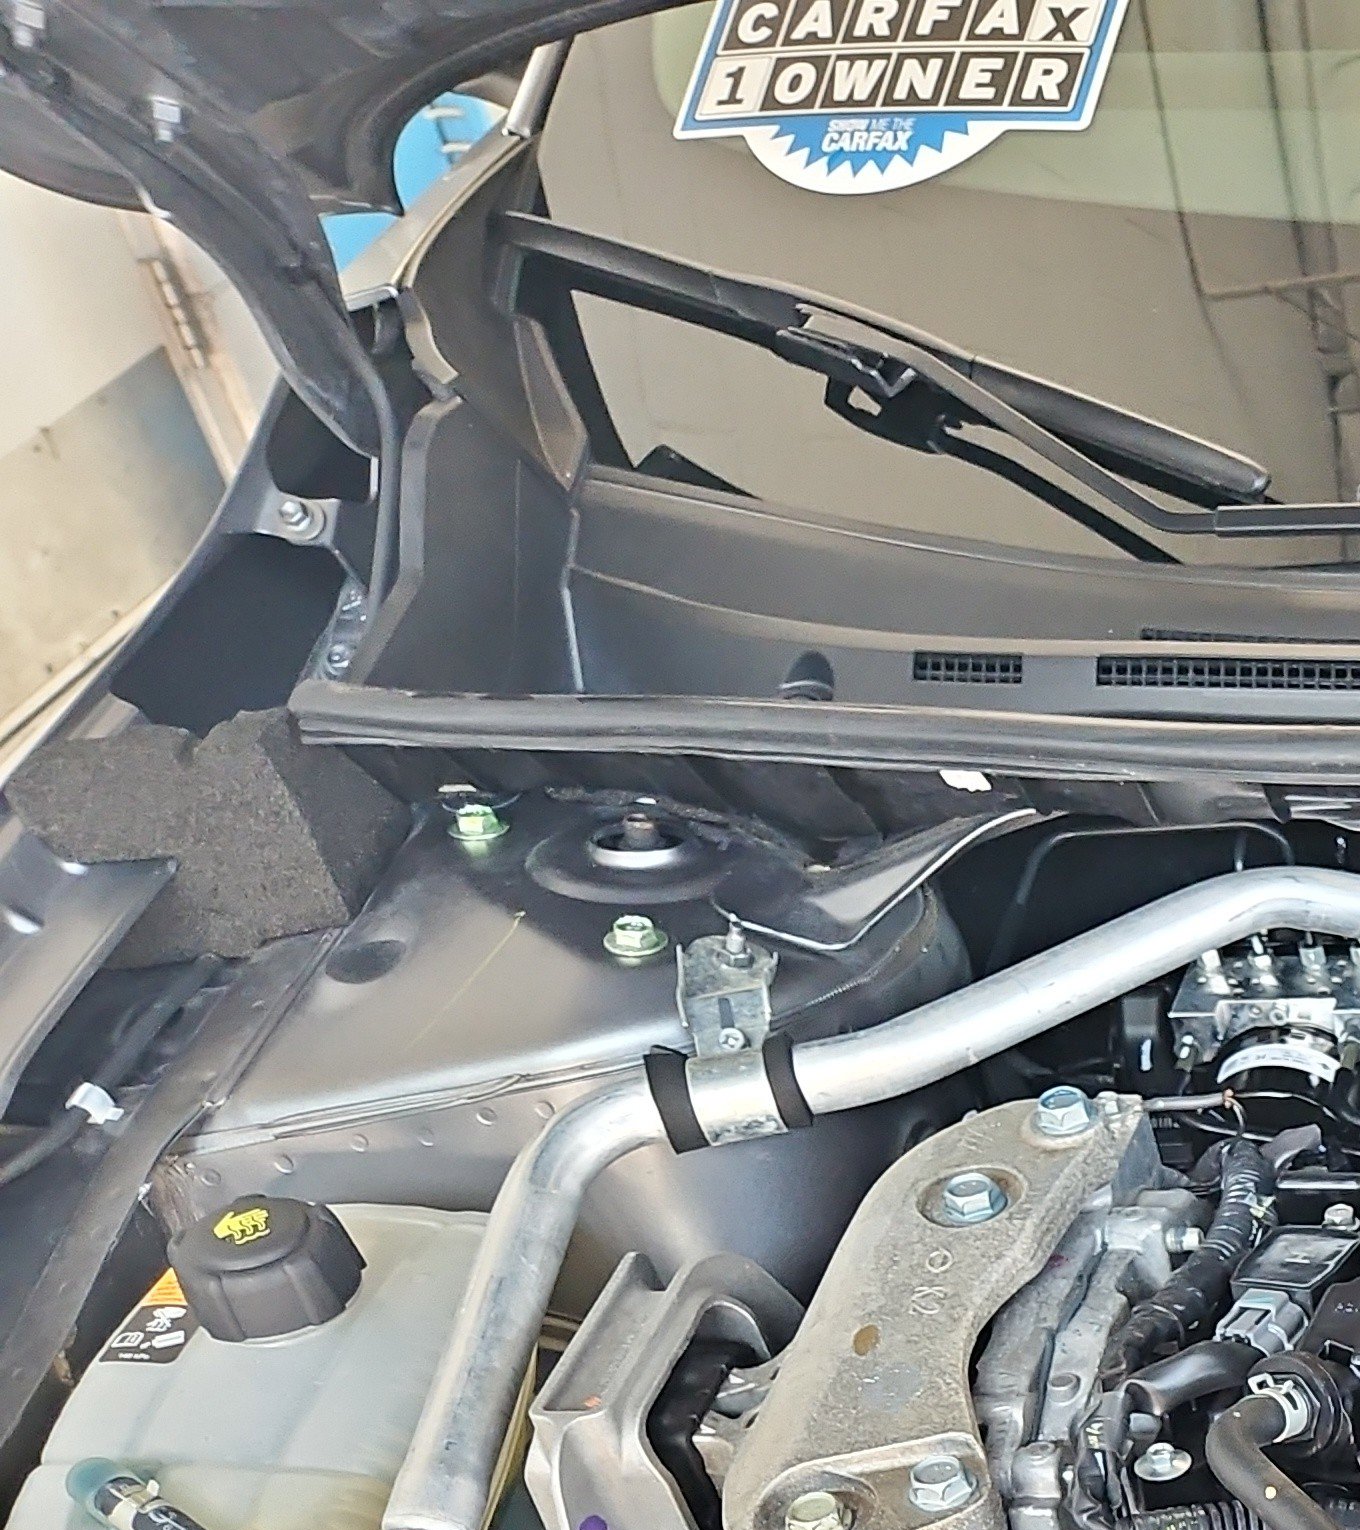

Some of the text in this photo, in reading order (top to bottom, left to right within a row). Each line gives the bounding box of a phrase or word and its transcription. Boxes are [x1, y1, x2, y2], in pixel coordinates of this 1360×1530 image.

[736, 0, 1088, 44] CARFAX
[772, 56, 1070, 105] OWNER
[822, 131, 913, 153] CARFAX
